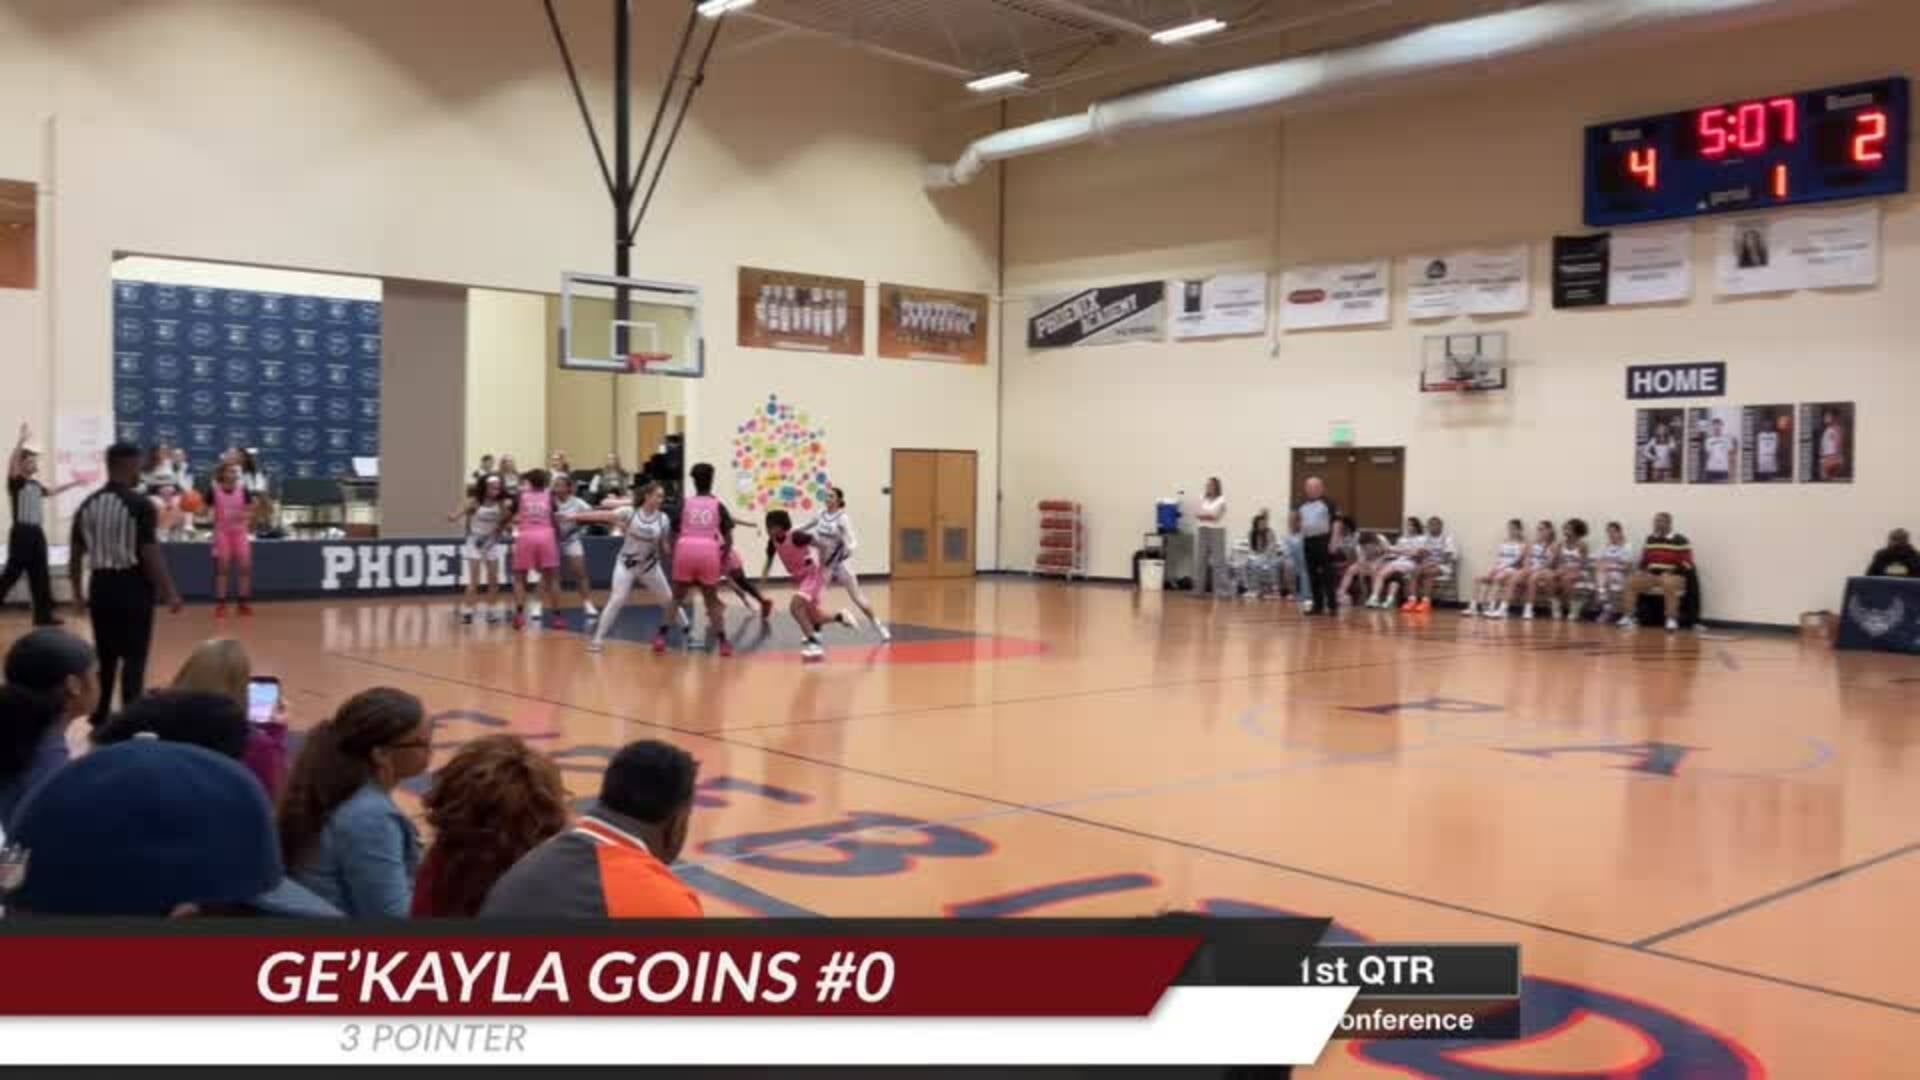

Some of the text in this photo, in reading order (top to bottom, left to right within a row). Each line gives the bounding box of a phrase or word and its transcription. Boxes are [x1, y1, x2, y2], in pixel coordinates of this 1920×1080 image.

[1698, 97, 1796, 156] 5:07
[1851, 111, 1888, 163] 2
[1628, 147, 1657, 188] 4
[1774, 164, 1787, 197] 1
[1633, 368, 1718, 394] HOME
